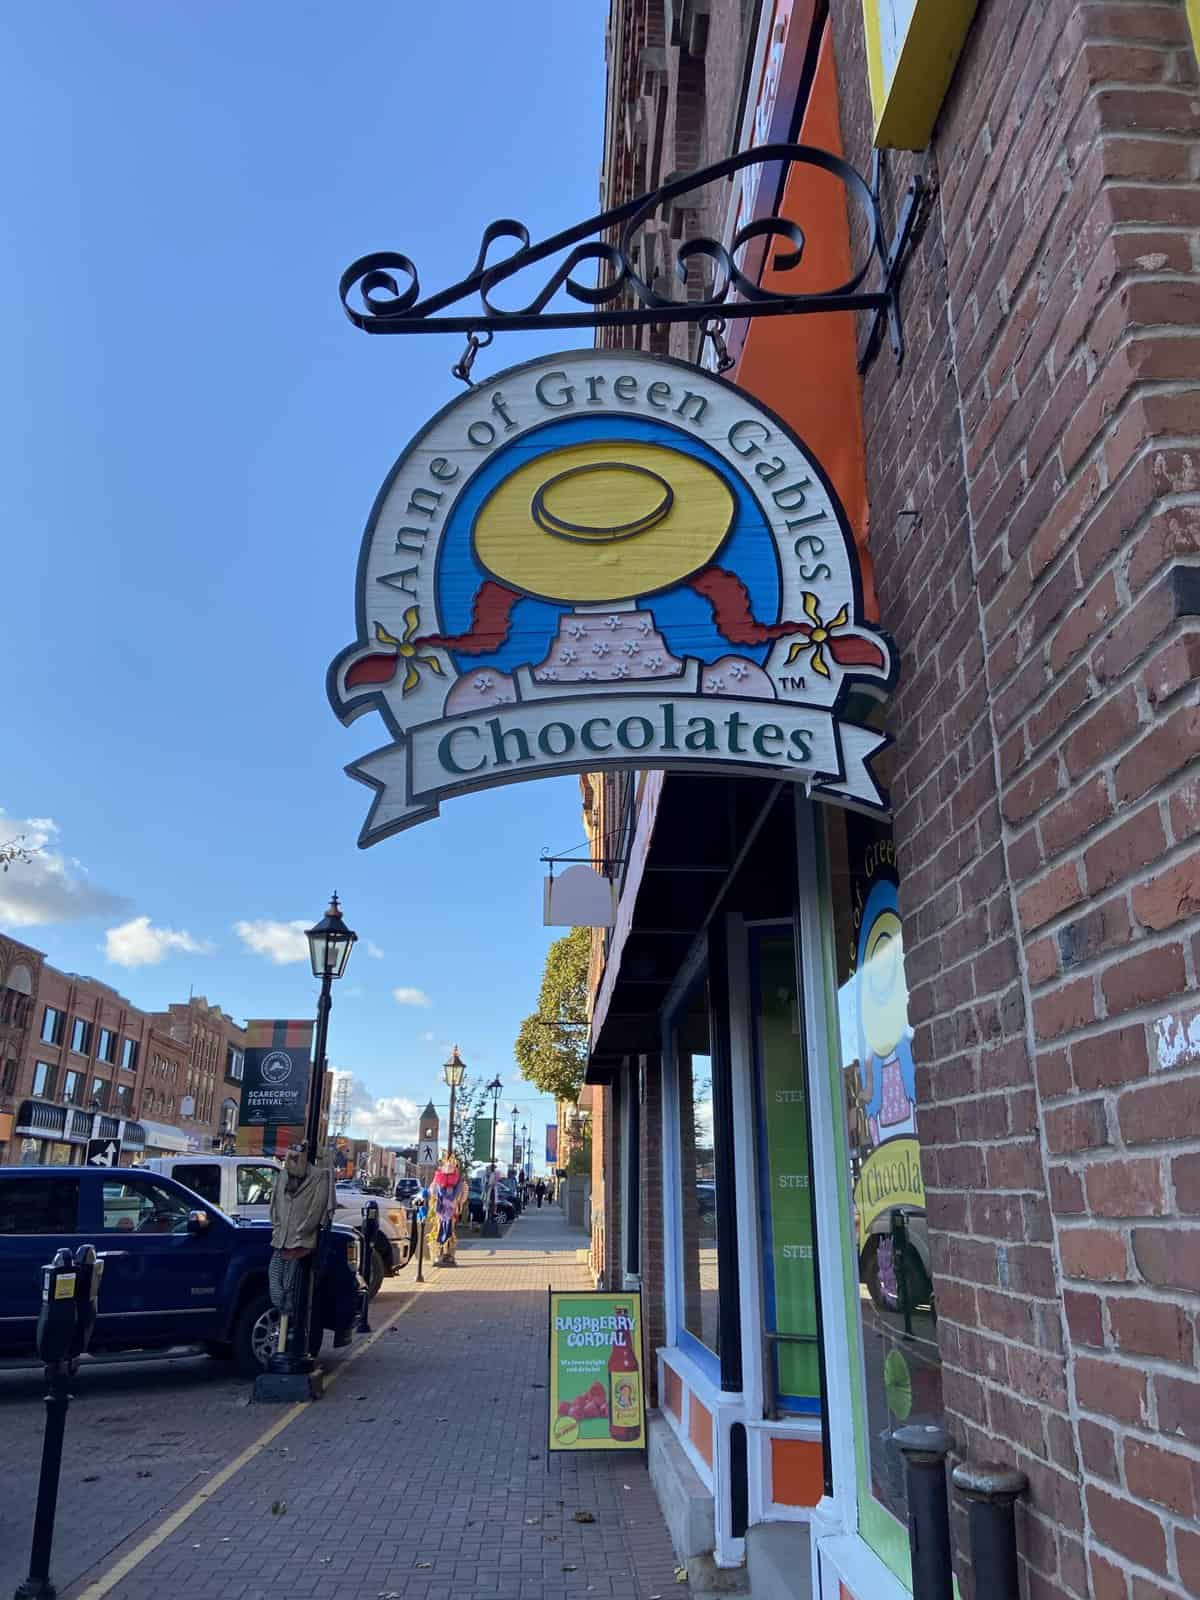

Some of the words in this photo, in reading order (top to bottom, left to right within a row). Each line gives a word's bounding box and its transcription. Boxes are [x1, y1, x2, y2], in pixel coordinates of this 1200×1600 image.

[376, 455, 461, 598] Anne
[466, 392, 518, 448] of
[535, 370, 710, 422] Green
[726, 418, 833, 584] Gables
[778, 676, 806, 691] TM
[436, 703, 816, 776] Chocolates
[247, 1098, 283, 1106] FESTIVAL
[248, 1090, 299, 1098] SCARECROW
[555, 1315, 636, 1332] RASPBERRY
[567, 1331, 626, 1347] CORDIAL
